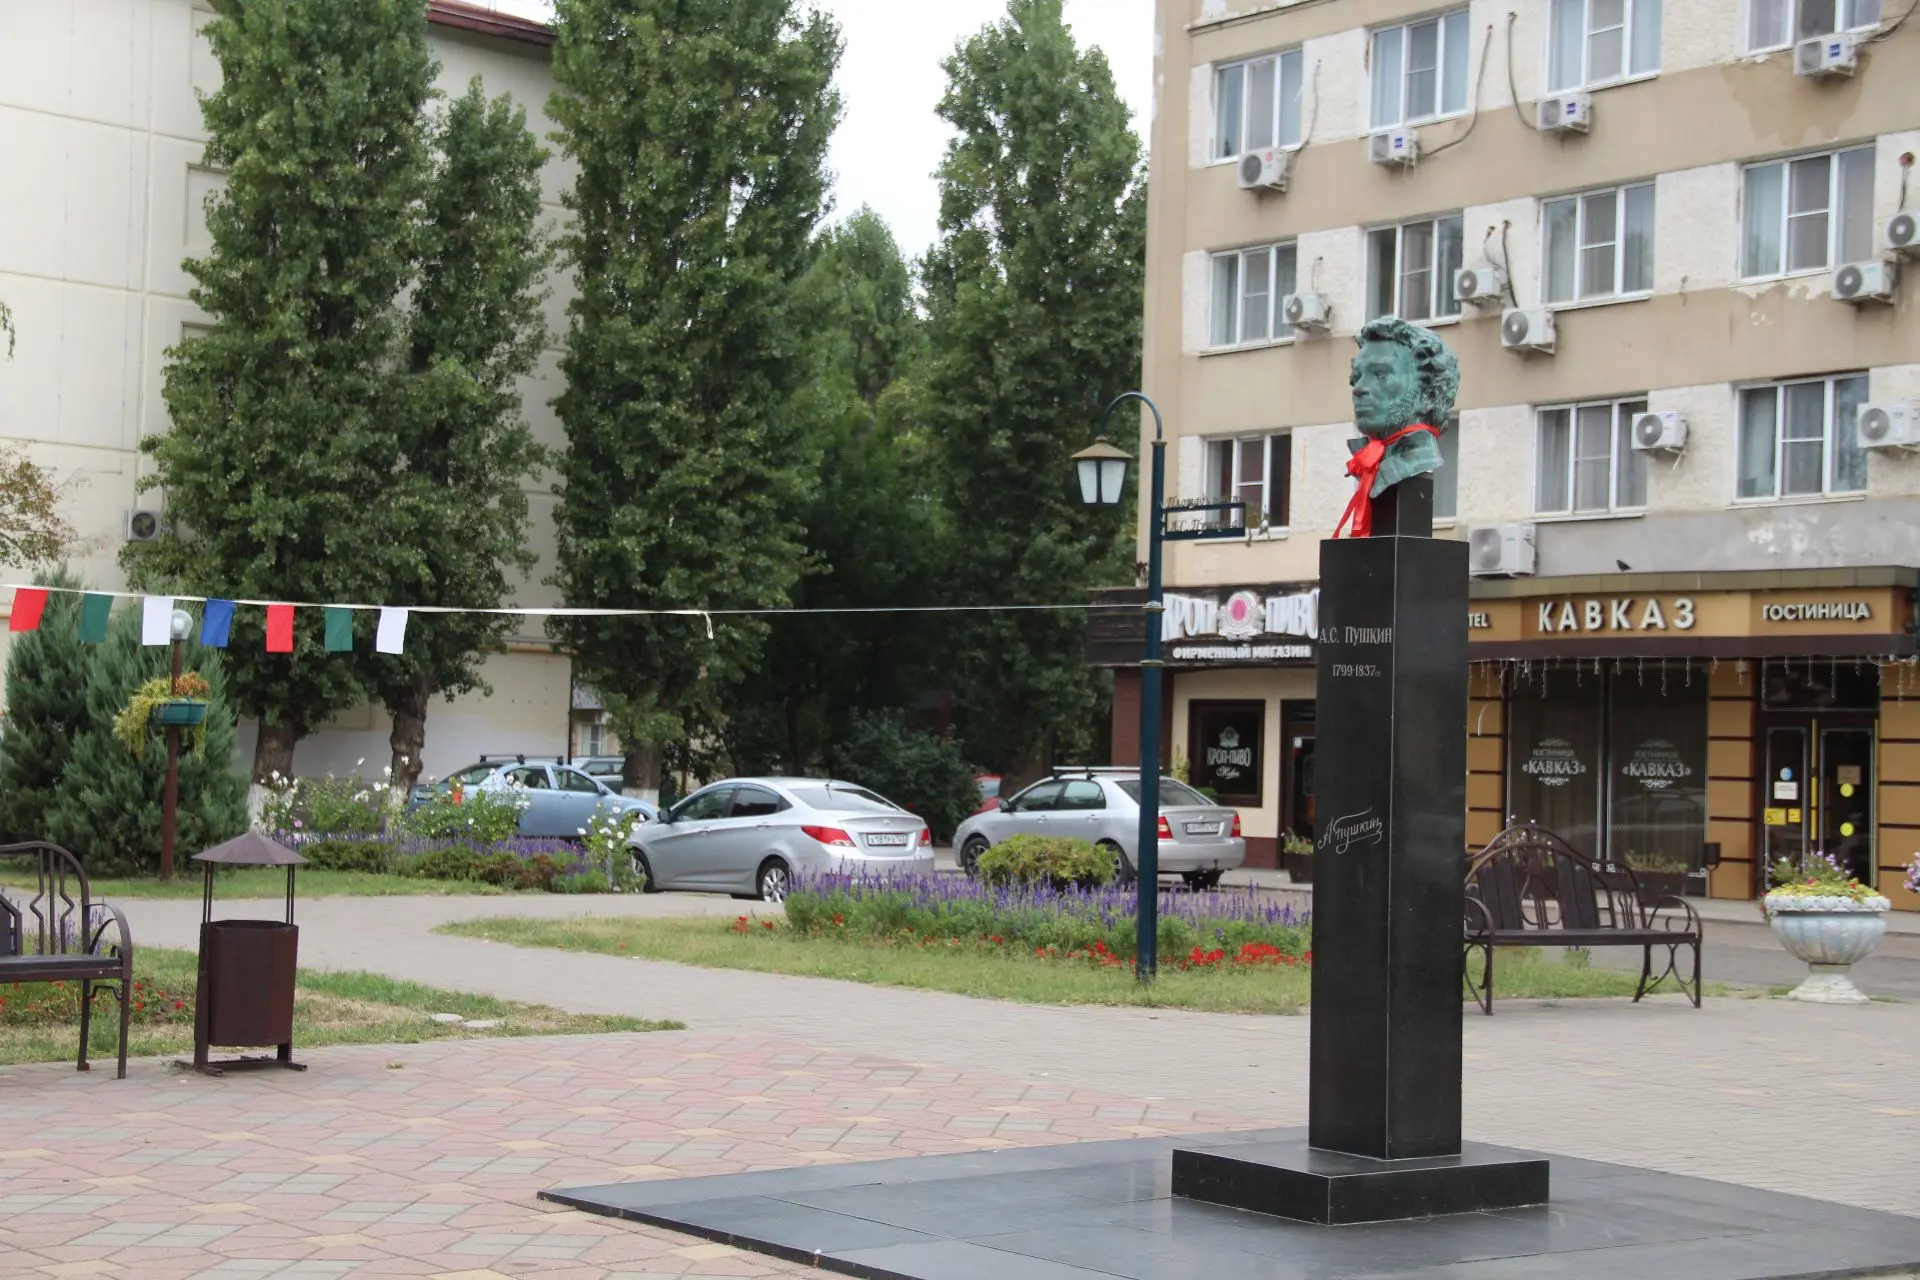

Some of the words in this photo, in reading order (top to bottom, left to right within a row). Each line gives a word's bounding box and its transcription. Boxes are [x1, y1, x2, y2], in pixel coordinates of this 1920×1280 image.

[1538, 598, 1695, 632] КАВКАЗ
[1762, 602, 1871, 620] ГОСТИНИЦА
[1468, 613, 1488, 627] TEL
[1319, 627, 1340, 644] А.С.
[1172, 643, 1252, 659] ФИРМЕННЫЙ
[1252, 645, 1312, 659] МАГАЗИН
[1522, 760, 1586, 774] «КАВКАЗ»
[1622, 762, 1691, 777] «КАВКАЗ»
